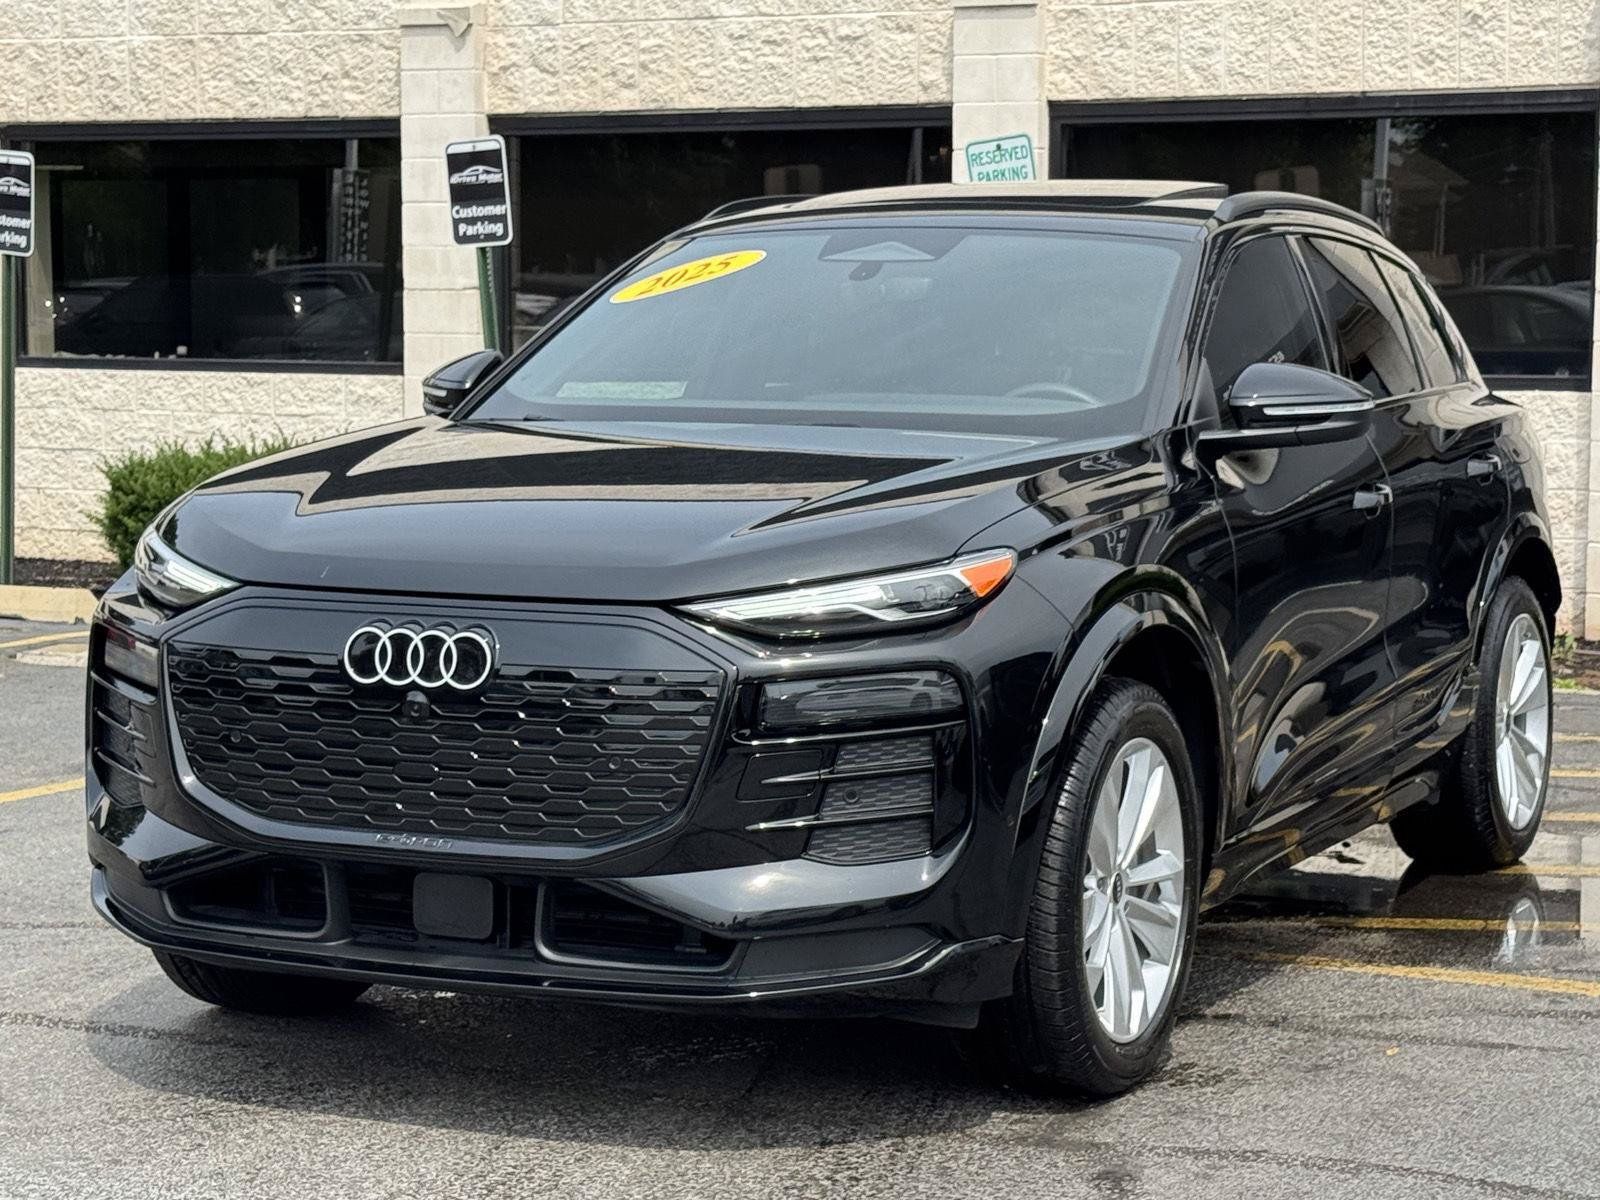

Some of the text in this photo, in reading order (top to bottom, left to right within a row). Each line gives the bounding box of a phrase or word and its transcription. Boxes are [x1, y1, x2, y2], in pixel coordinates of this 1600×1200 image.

[970, 145, 1028, 167] RESERVED
[977, 165, 1028, 182] PARKING
[452, 205, 506, 219] Customer
[458, 221, 503, 236] Parking
[0, 231, 27, 248] rking
[636, 256, 738, 296] 2025
